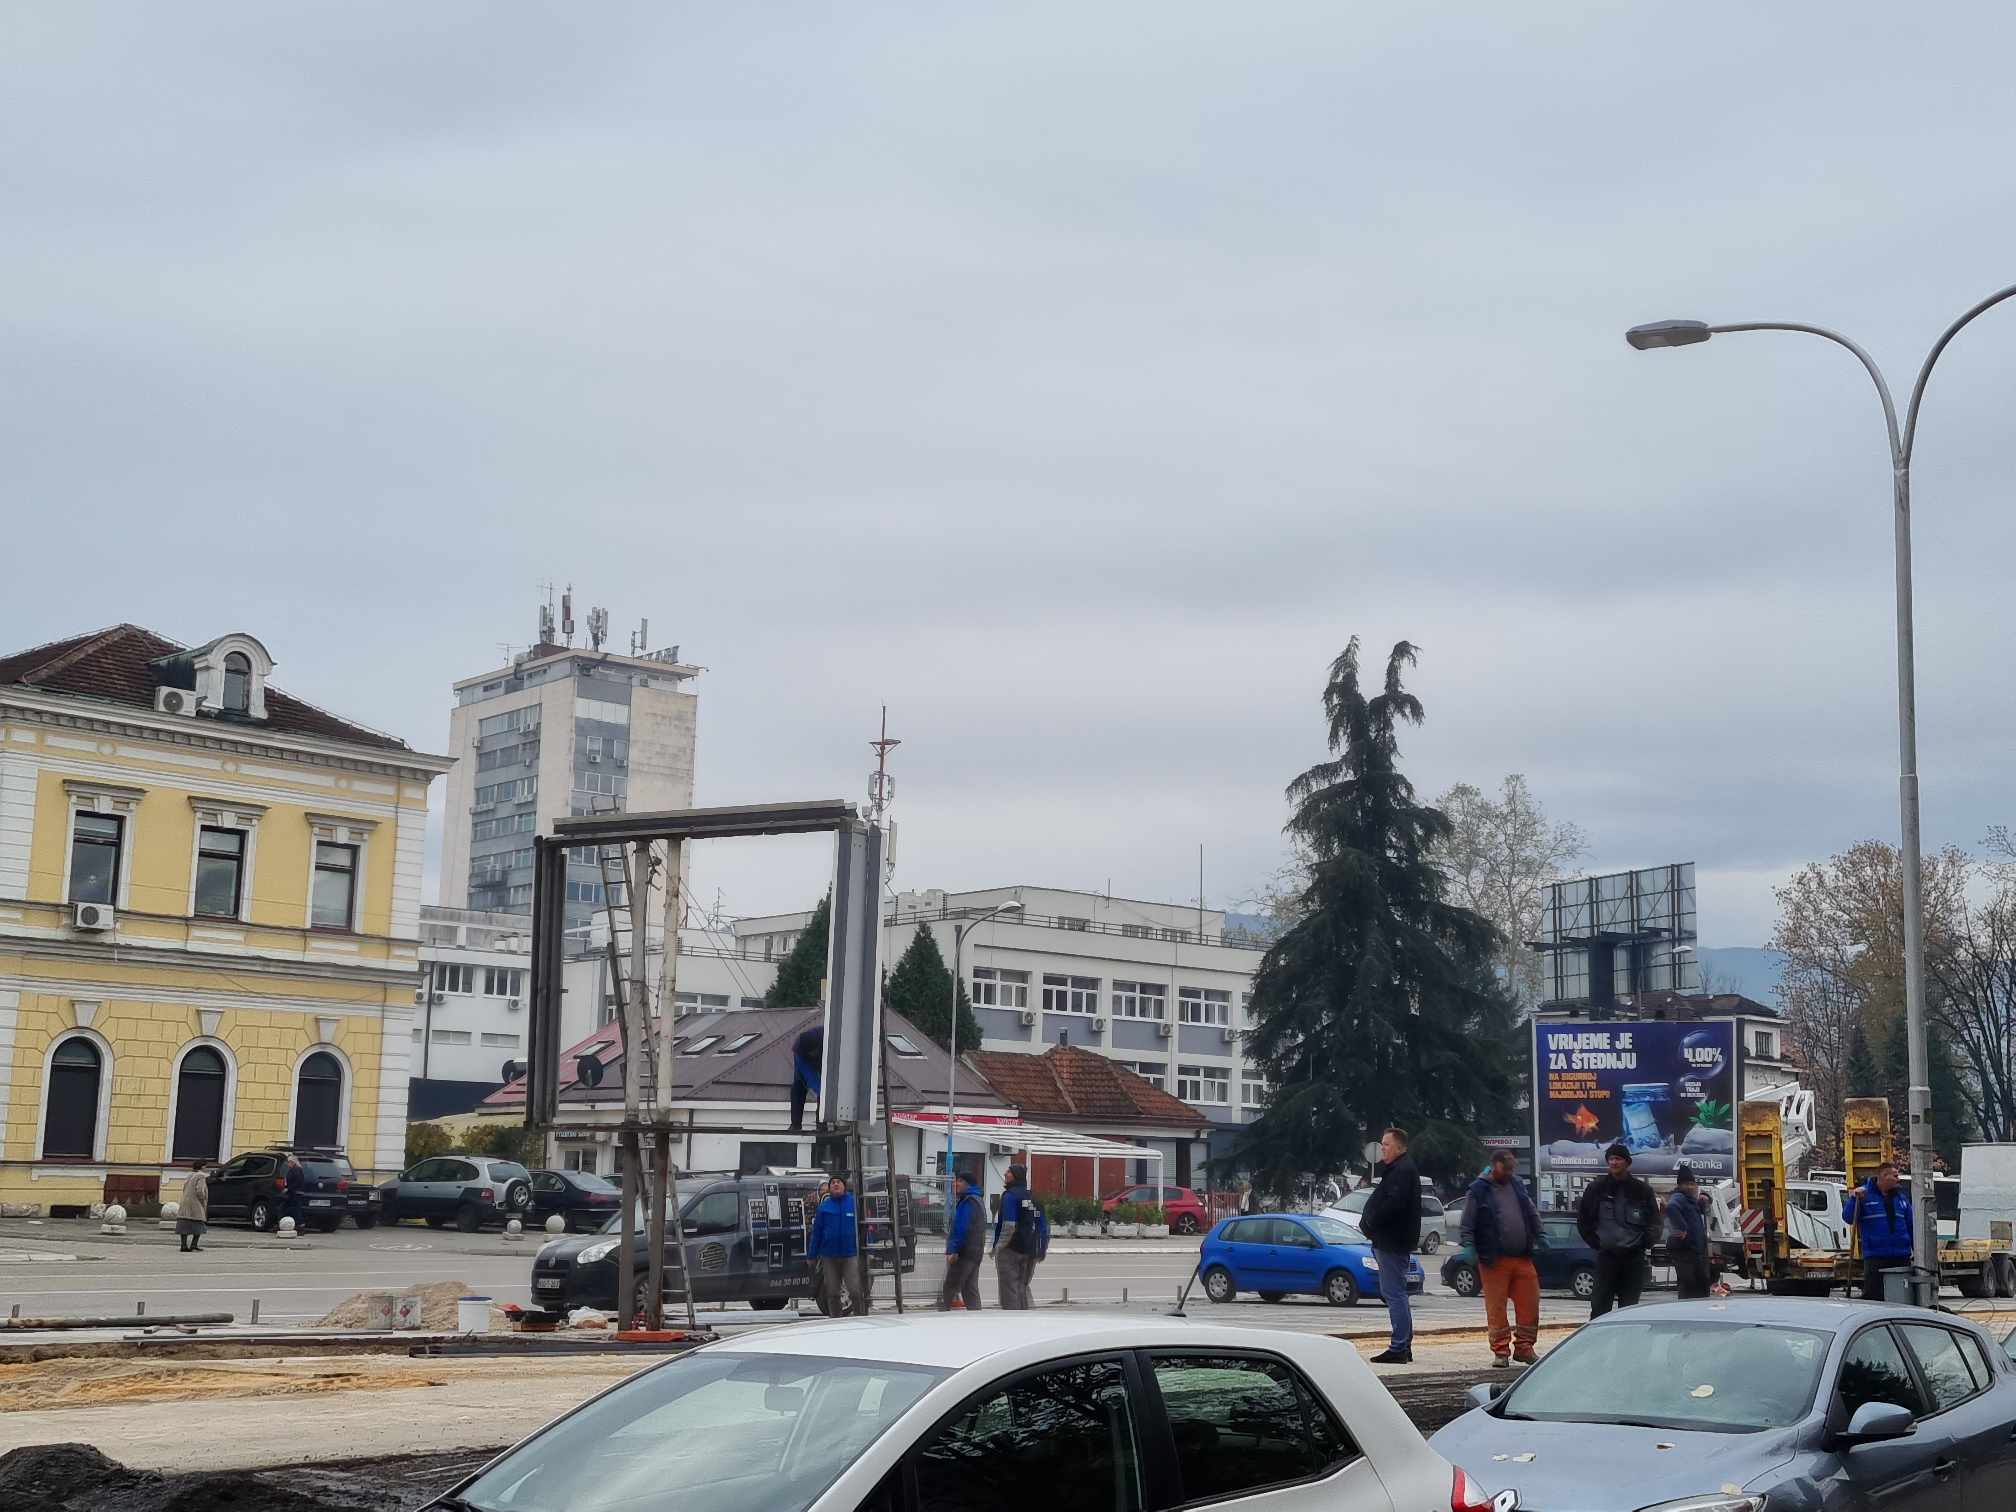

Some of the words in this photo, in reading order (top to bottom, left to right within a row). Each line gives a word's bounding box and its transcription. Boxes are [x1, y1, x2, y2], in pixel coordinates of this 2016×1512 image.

[1547, 1032, 1611, 1050] VRIJEME
[1615, 1032, 1633, 1049] JE
[1548, 1053, 1568, 1070] ZA
[1571, 1049, 1637, 1070] ŠTEDNJU
[1691, 1158, 1723, 1170] banka
